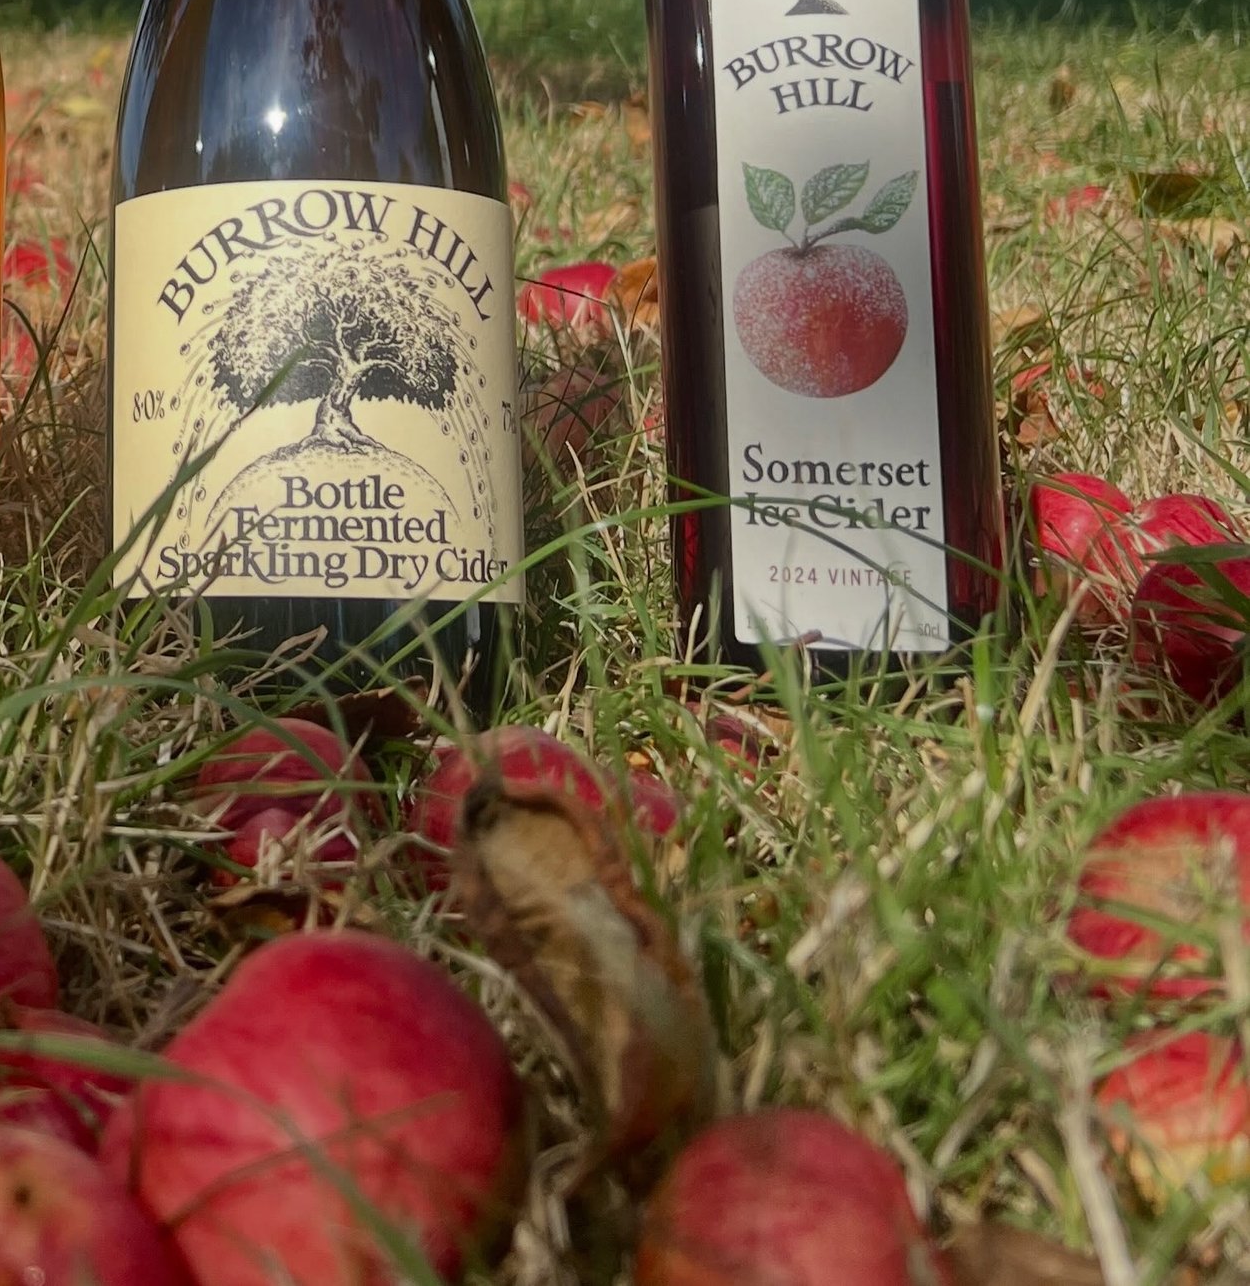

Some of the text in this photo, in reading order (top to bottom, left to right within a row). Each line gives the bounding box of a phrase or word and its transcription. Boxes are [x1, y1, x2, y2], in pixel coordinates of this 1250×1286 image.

[722, 32, 916, 92] BURROW
[769, 76, 875, 115] HILL
[156, 188, 495, 327] BURROW HILL
[741, 441, 931, 487] Somerset
[279, 473, 406, 511] Bottle
[744, 491, 931, 531] Ice Cider
[230, 504, 452, 544] Fermented
[156, 540, 508, 590] Sparkling Dry Cider
[769, 565, 818, 585] 2024
